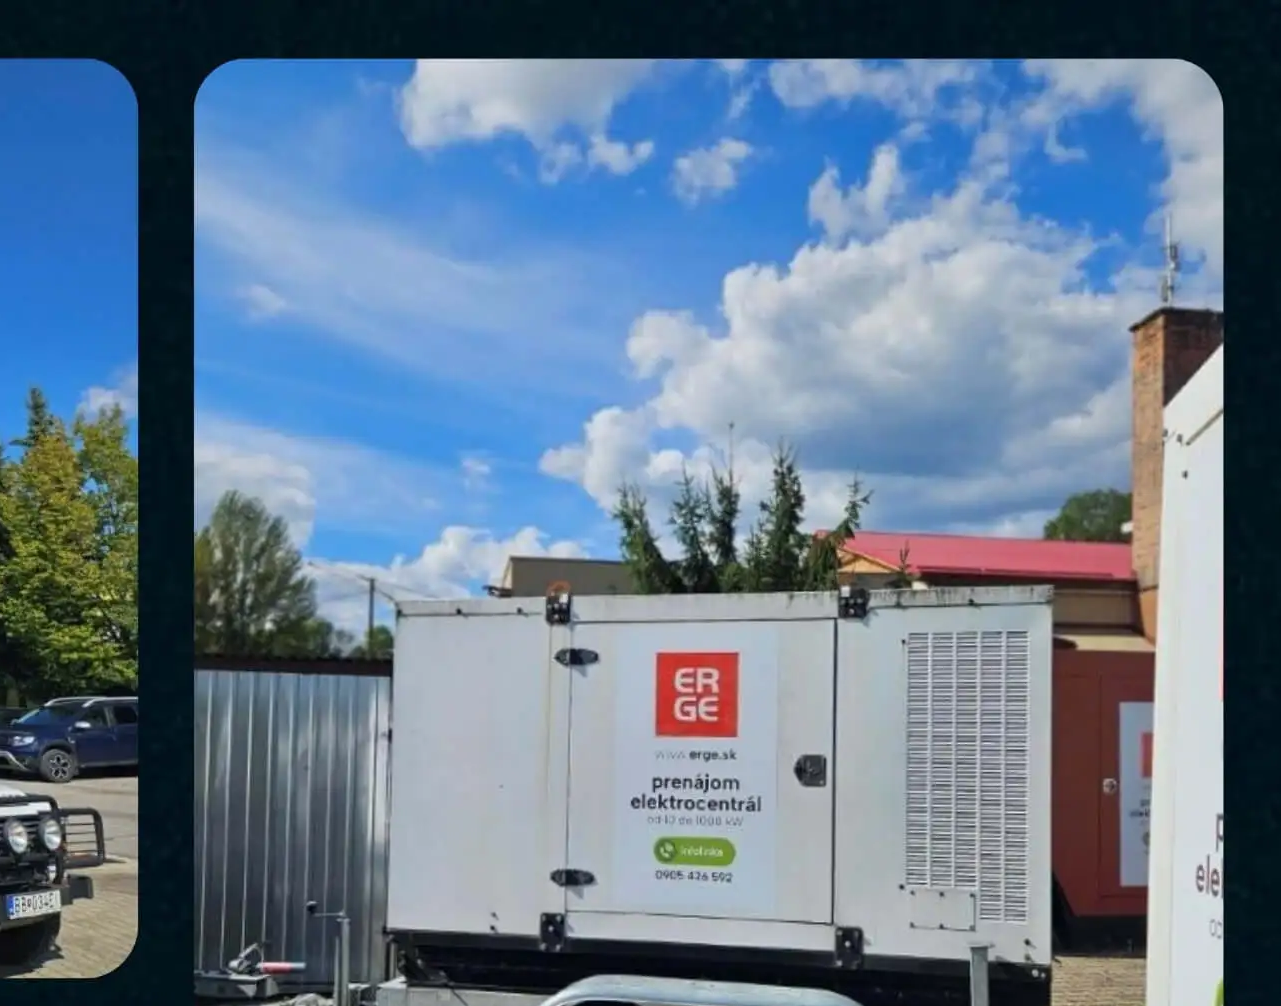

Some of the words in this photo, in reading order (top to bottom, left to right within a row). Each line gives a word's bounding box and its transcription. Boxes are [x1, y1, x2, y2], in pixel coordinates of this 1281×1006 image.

[674, 667, 720, 694] ER
[674, 696, 719, 722] GE
[652, 773, 741, 793] prenájom
[630, 793, 762, 813] elektrocentrál
[711, 871, 733, 883] 592
